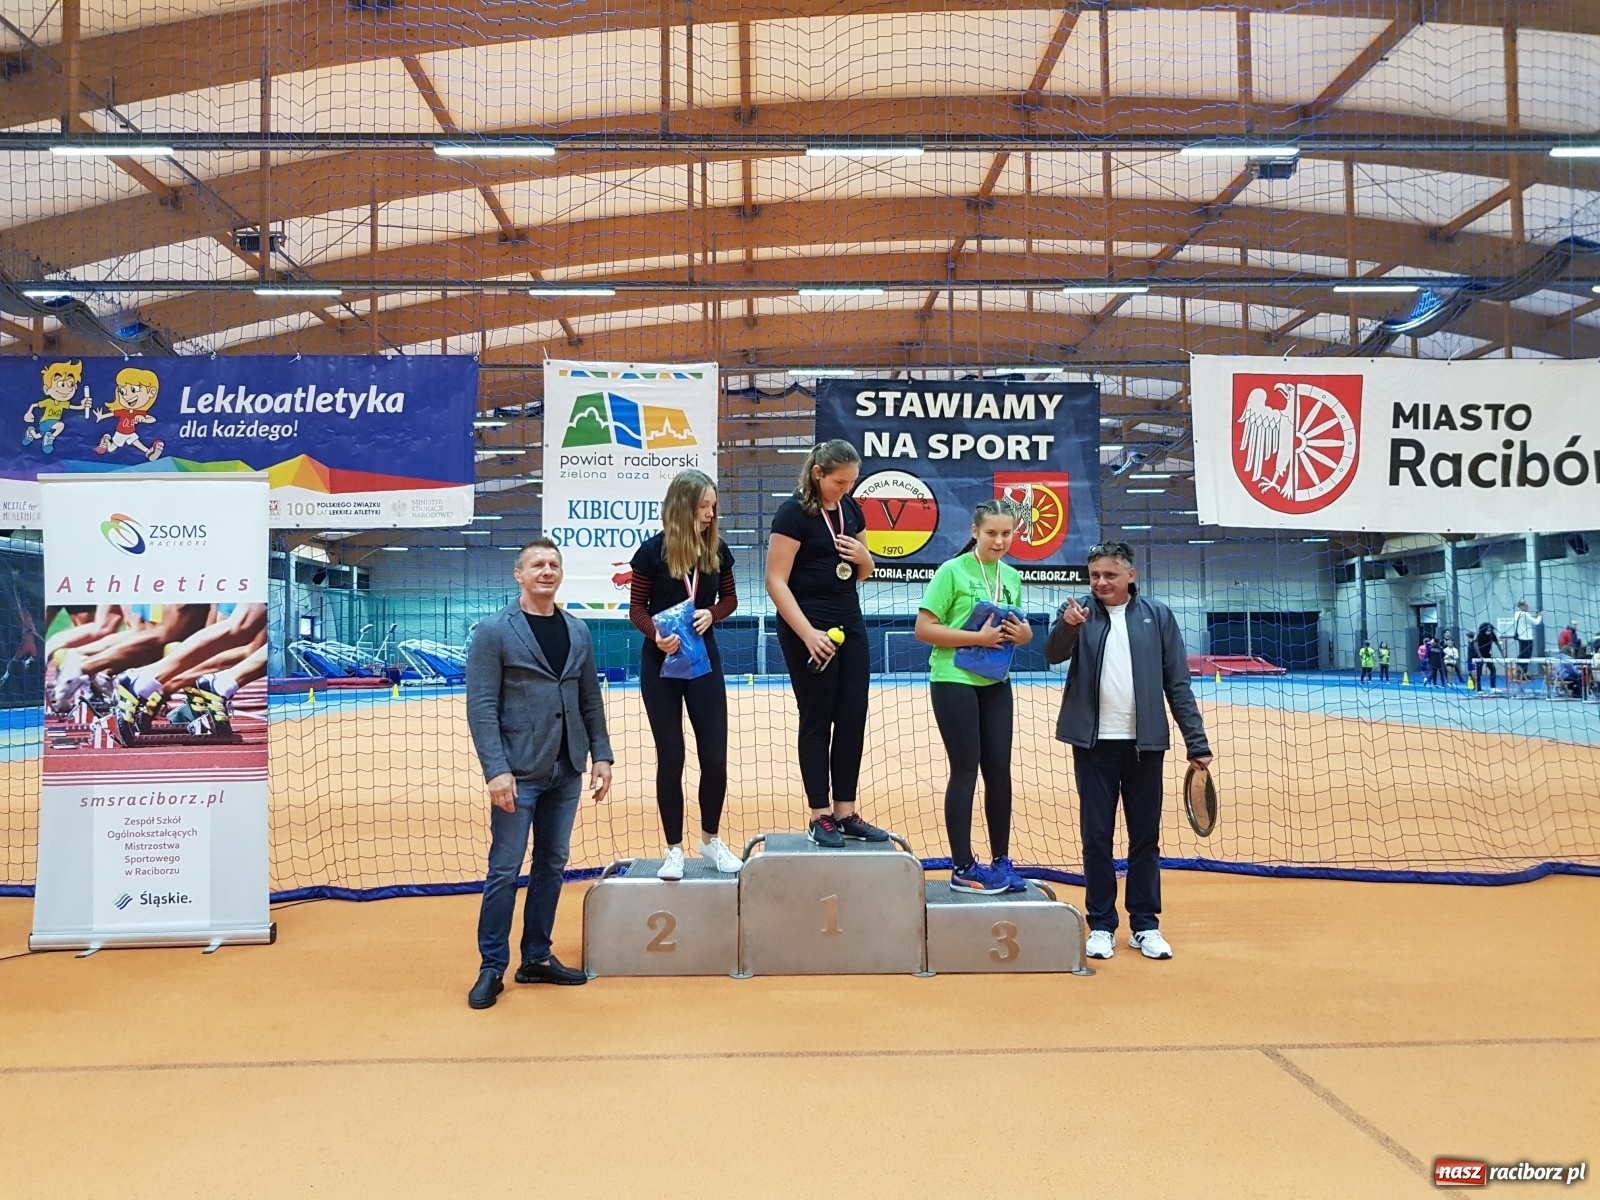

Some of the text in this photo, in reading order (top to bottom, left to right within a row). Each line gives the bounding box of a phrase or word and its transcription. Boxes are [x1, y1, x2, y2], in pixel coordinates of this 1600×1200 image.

[180, 384, 405, 419] Lekkoatletyka
[855, 391, 1064, 420] STAWIAMY
[1392, 401, 1532, 431] MIASTO
[179, 419, 299, 441] dla każdego!
[863, 431, 1055, 461] NA SPORT
[560, 453, 699, 469] powiat raciborski
[560, 470, 607, 479] zielona
[617, 472, 649, 480] oaza
[858, 479, 890, 508] ICTORIA
[287, 502, 315, 516] 100
[353, 501, 381, 509] ZWIĄZKU
[149, 524, 207, 539] ZSOMS
[149, 539, 207, 547] RACIBÓRZ
[882, 545, 904, 555] 1970
[56, 573, 249, 593] Athletics
[80, 789, 225, 808] smsraciborz.pl
[124, 815, 181, 827] Zespół Szkół
[107, 827, 198, 841] Ogólnokształcących
[124, 841, 180, 851] Mistrzostwa
[124, 854, 181, 865] Sportowego
[135, 866, 180, 876] Raciborzu
[139, 890, 193, 907] Śląskie.
[820, 893, 844, 936] 1
[646, 910, 678, 952] 2
[989, 920, 1020, 963] 3
